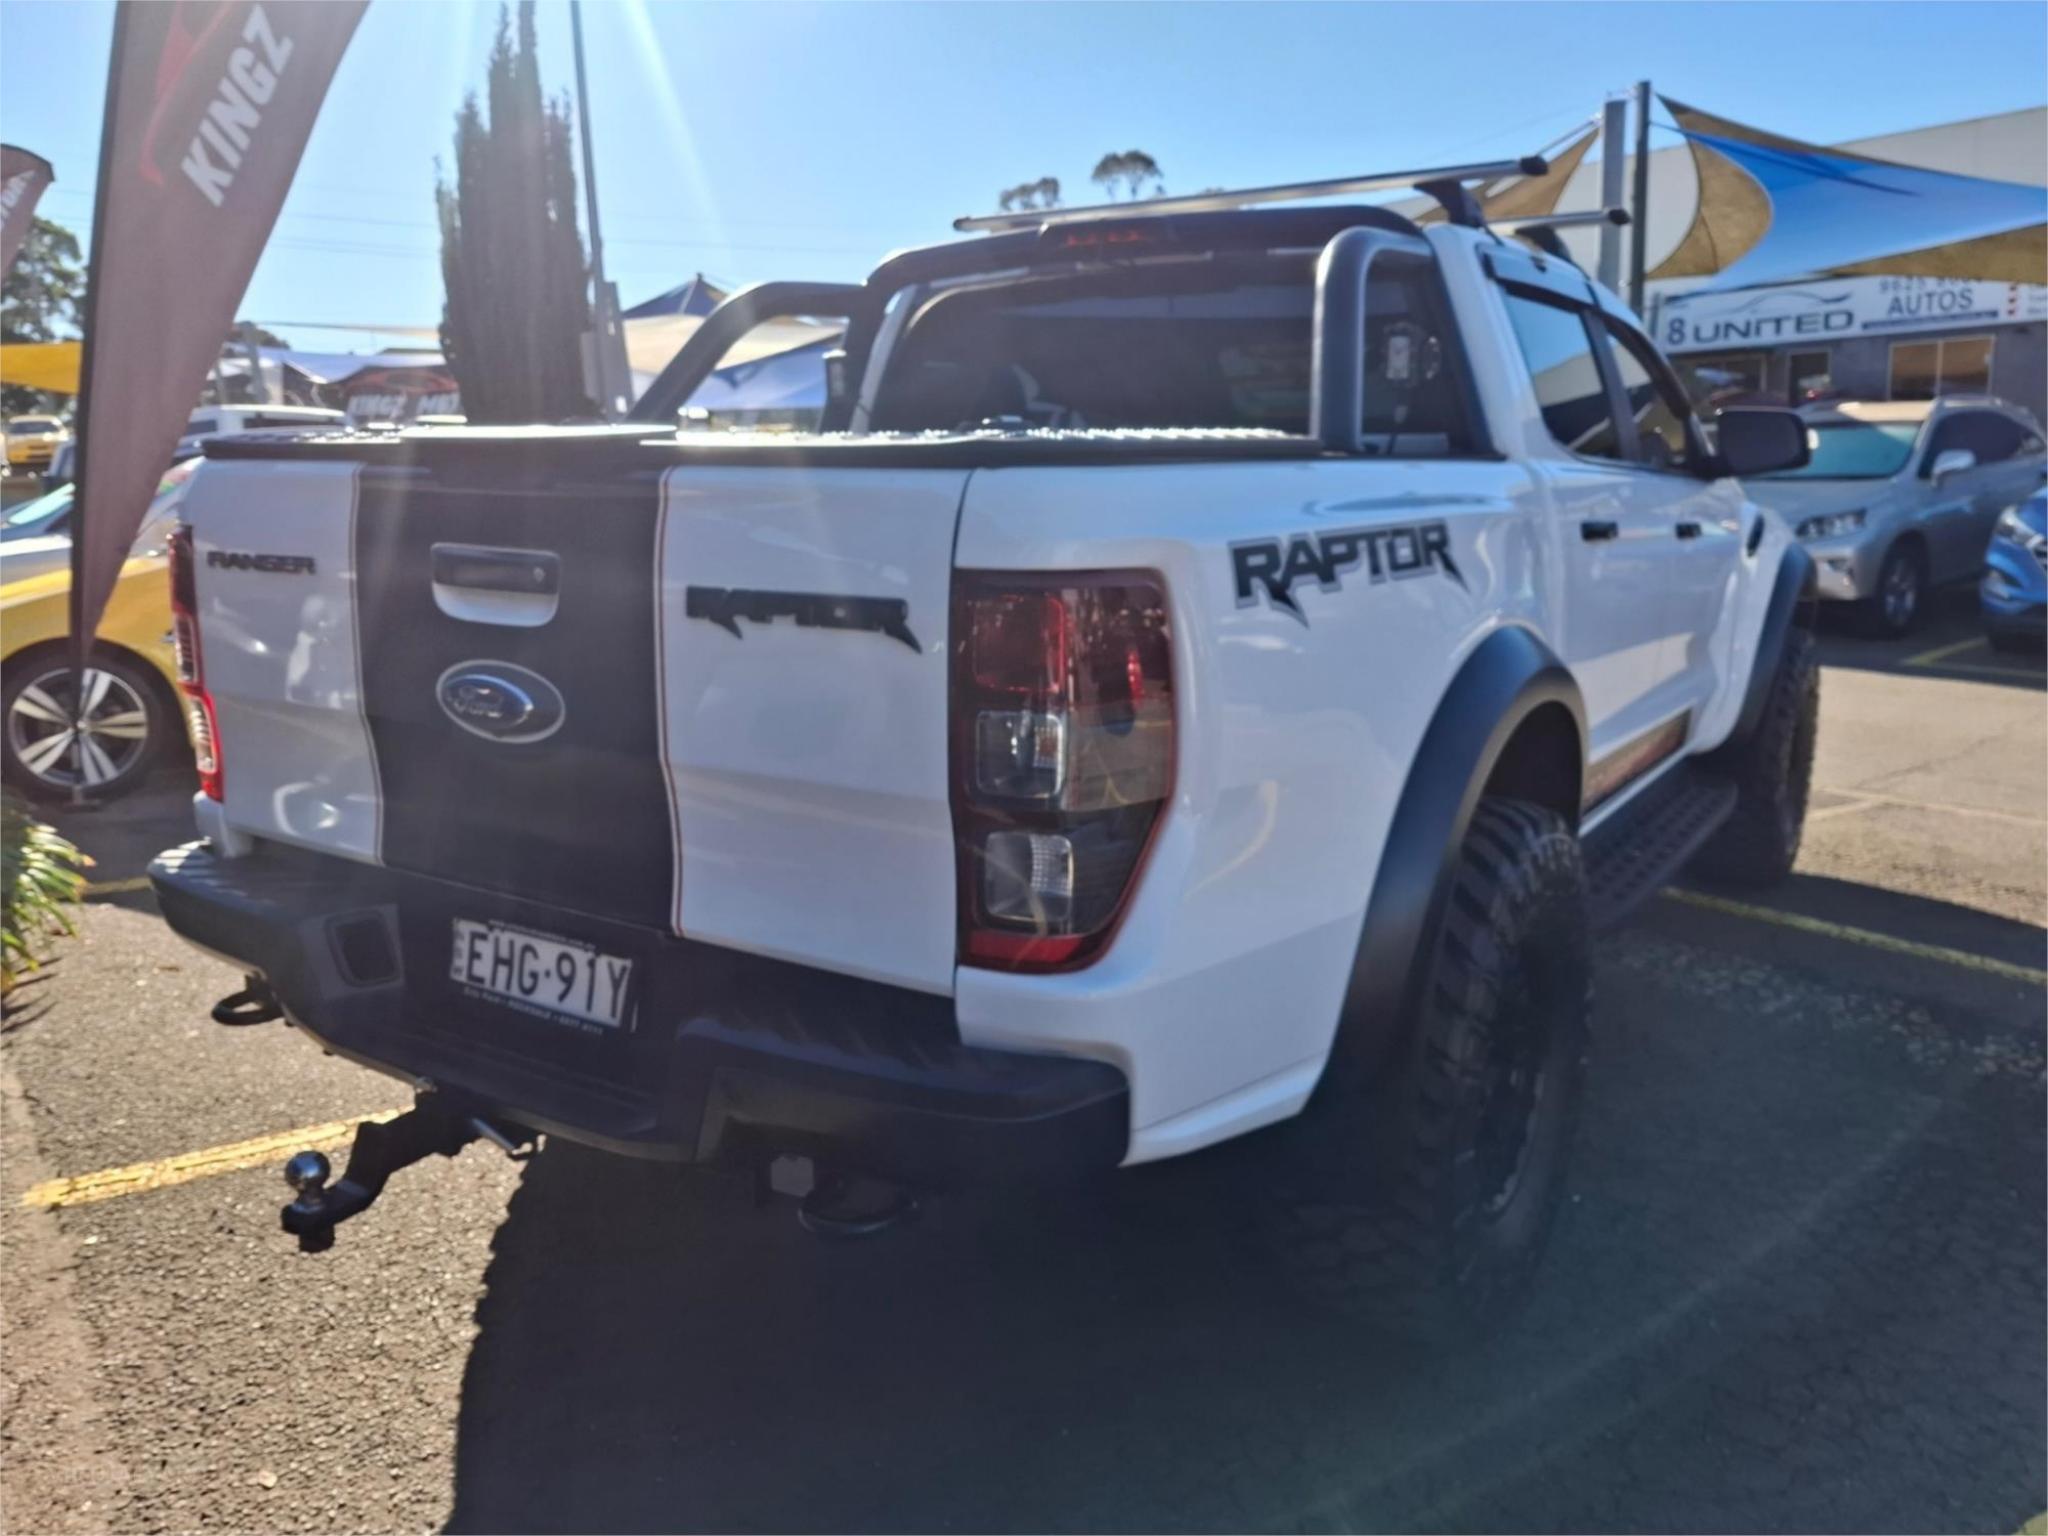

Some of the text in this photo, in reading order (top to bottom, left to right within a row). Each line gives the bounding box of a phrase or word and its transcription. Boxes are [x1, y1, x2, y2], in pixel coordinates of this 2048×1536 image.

[181, 4, 293, 206] KINGZ
[1667, 309, 1854, 345] 8 UNITED
[1887, 287, 1974, 317] AUTOS
[1227, 517, 1472, 630] RAPTOR
